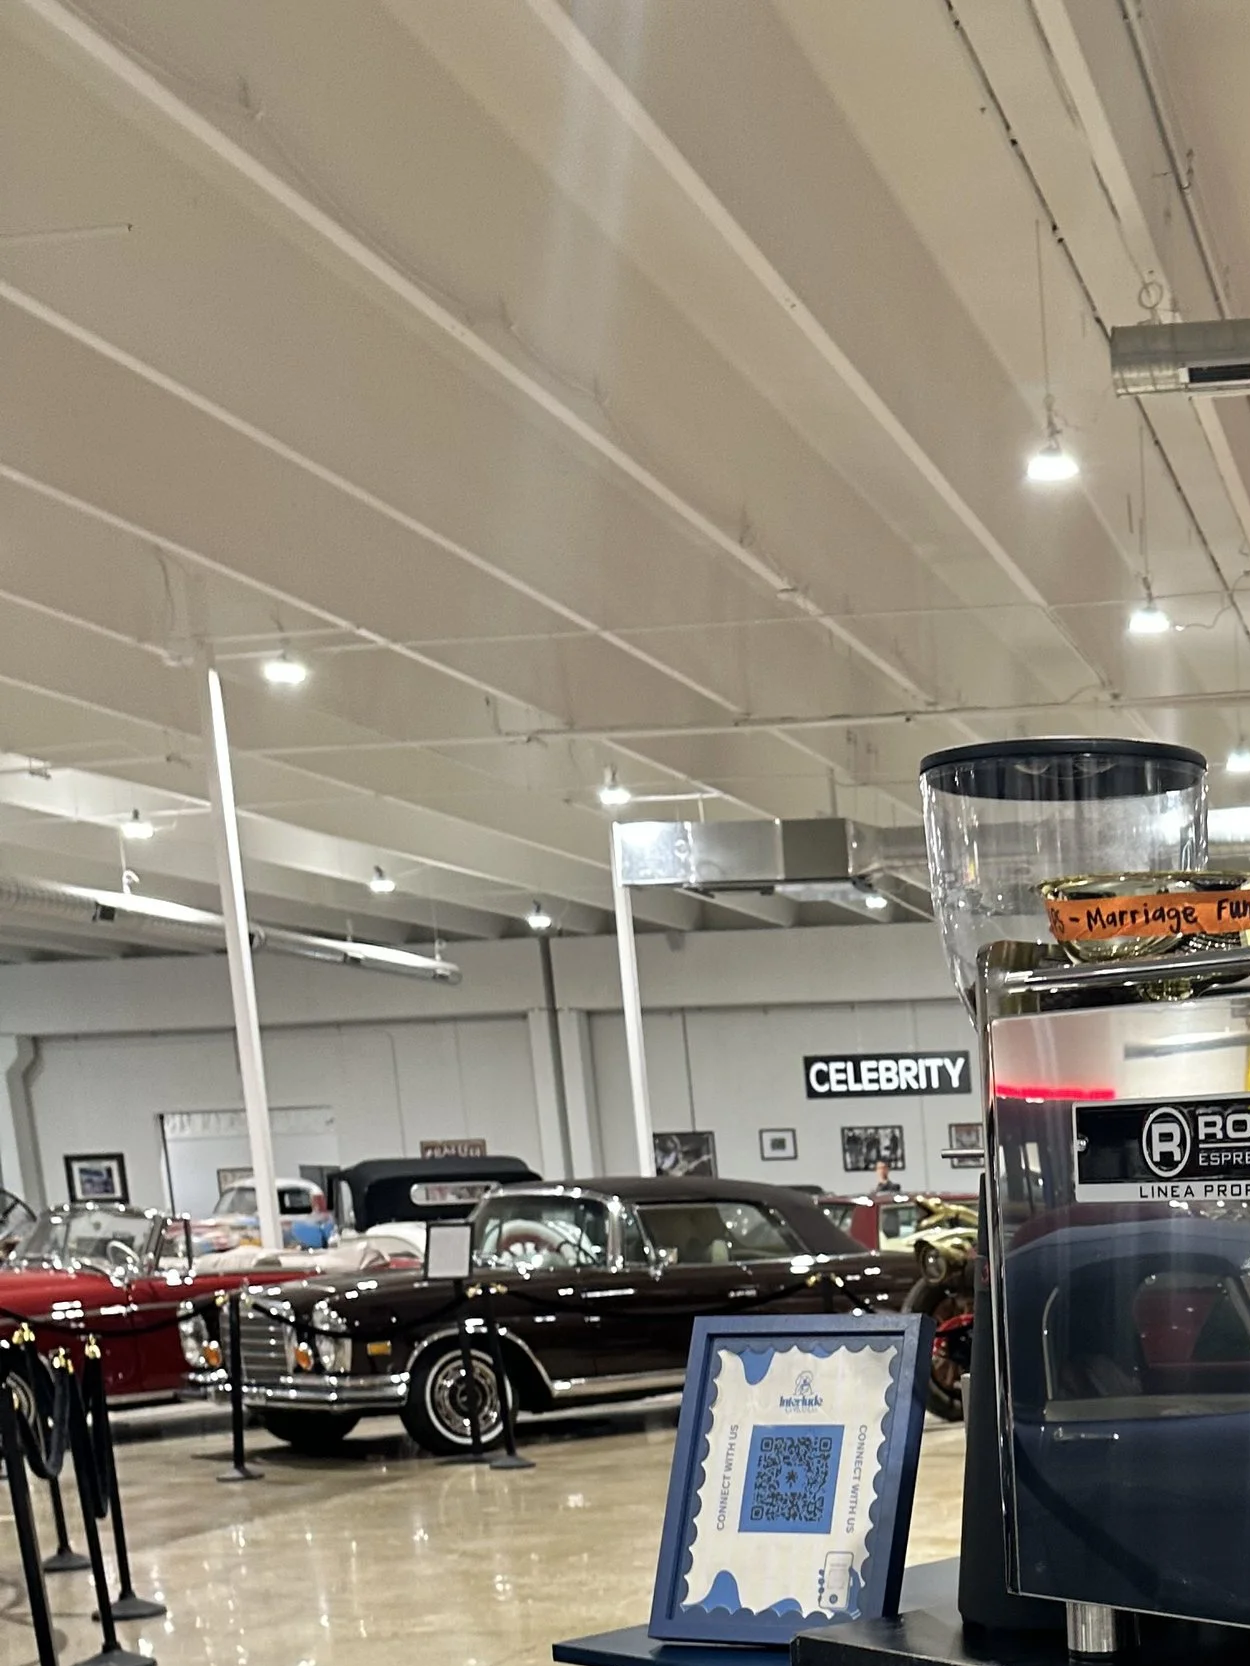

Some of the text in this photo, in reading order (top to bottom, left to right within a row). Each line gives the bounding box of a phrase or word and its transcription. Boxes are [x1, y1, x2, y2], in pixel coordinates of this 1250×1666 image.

[1086, 902, 1198, 933] Marriage
[809, 1057, 966, 1092] CELEBRITY
[1140, 1184, 1195, 1199] LINEA
[716, 1424, 739, 1531] CONNECT WITH US
[846, 1425, 868, 1534] CONNECT WITH US
